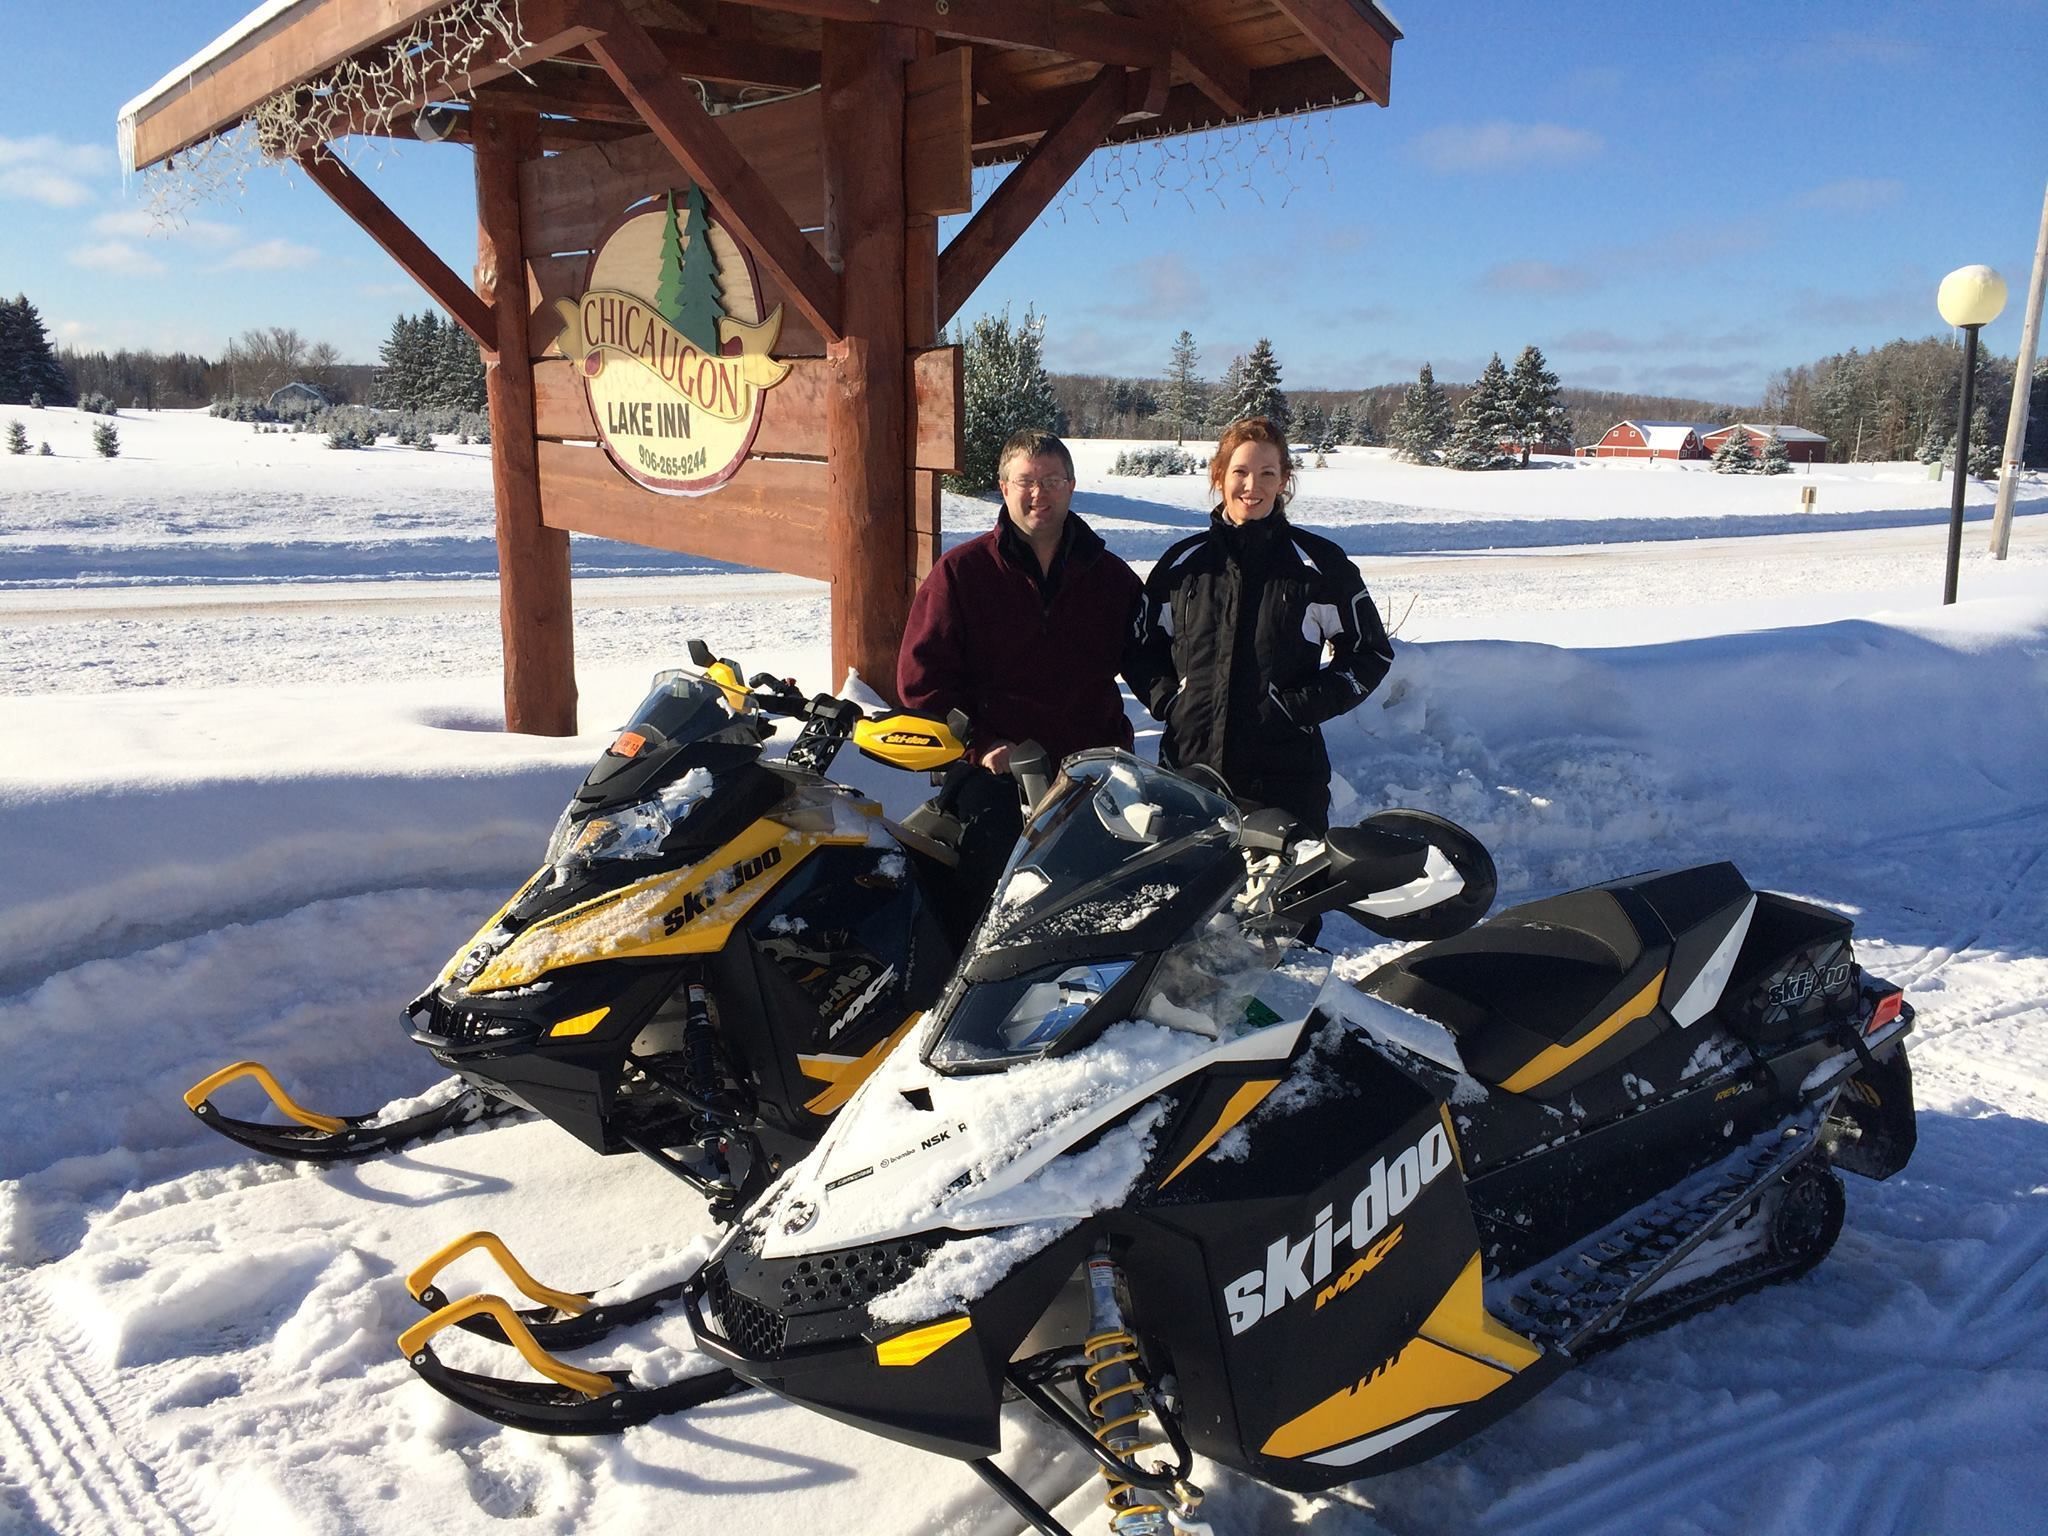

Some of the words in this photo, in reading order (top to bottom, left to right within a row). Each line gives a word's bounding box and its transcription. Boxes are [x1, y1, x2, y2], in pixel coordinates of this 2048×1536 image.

[583, 297, 738, 416] CHICAUGON
[607, 401, 654, 437] LAKE
[657, 403, 691, 439] INN
[638, 444, 707, 476] 906-265-9244
[885, 734, 931, 746] ski-doo
[663, 846, 782, 937] skdoo
[920, 1130, 951, 1151] NSK
[1223, 1121, 1453, 1337] ski-doo
[1314, 1223, 1404, 1311] MXZ
